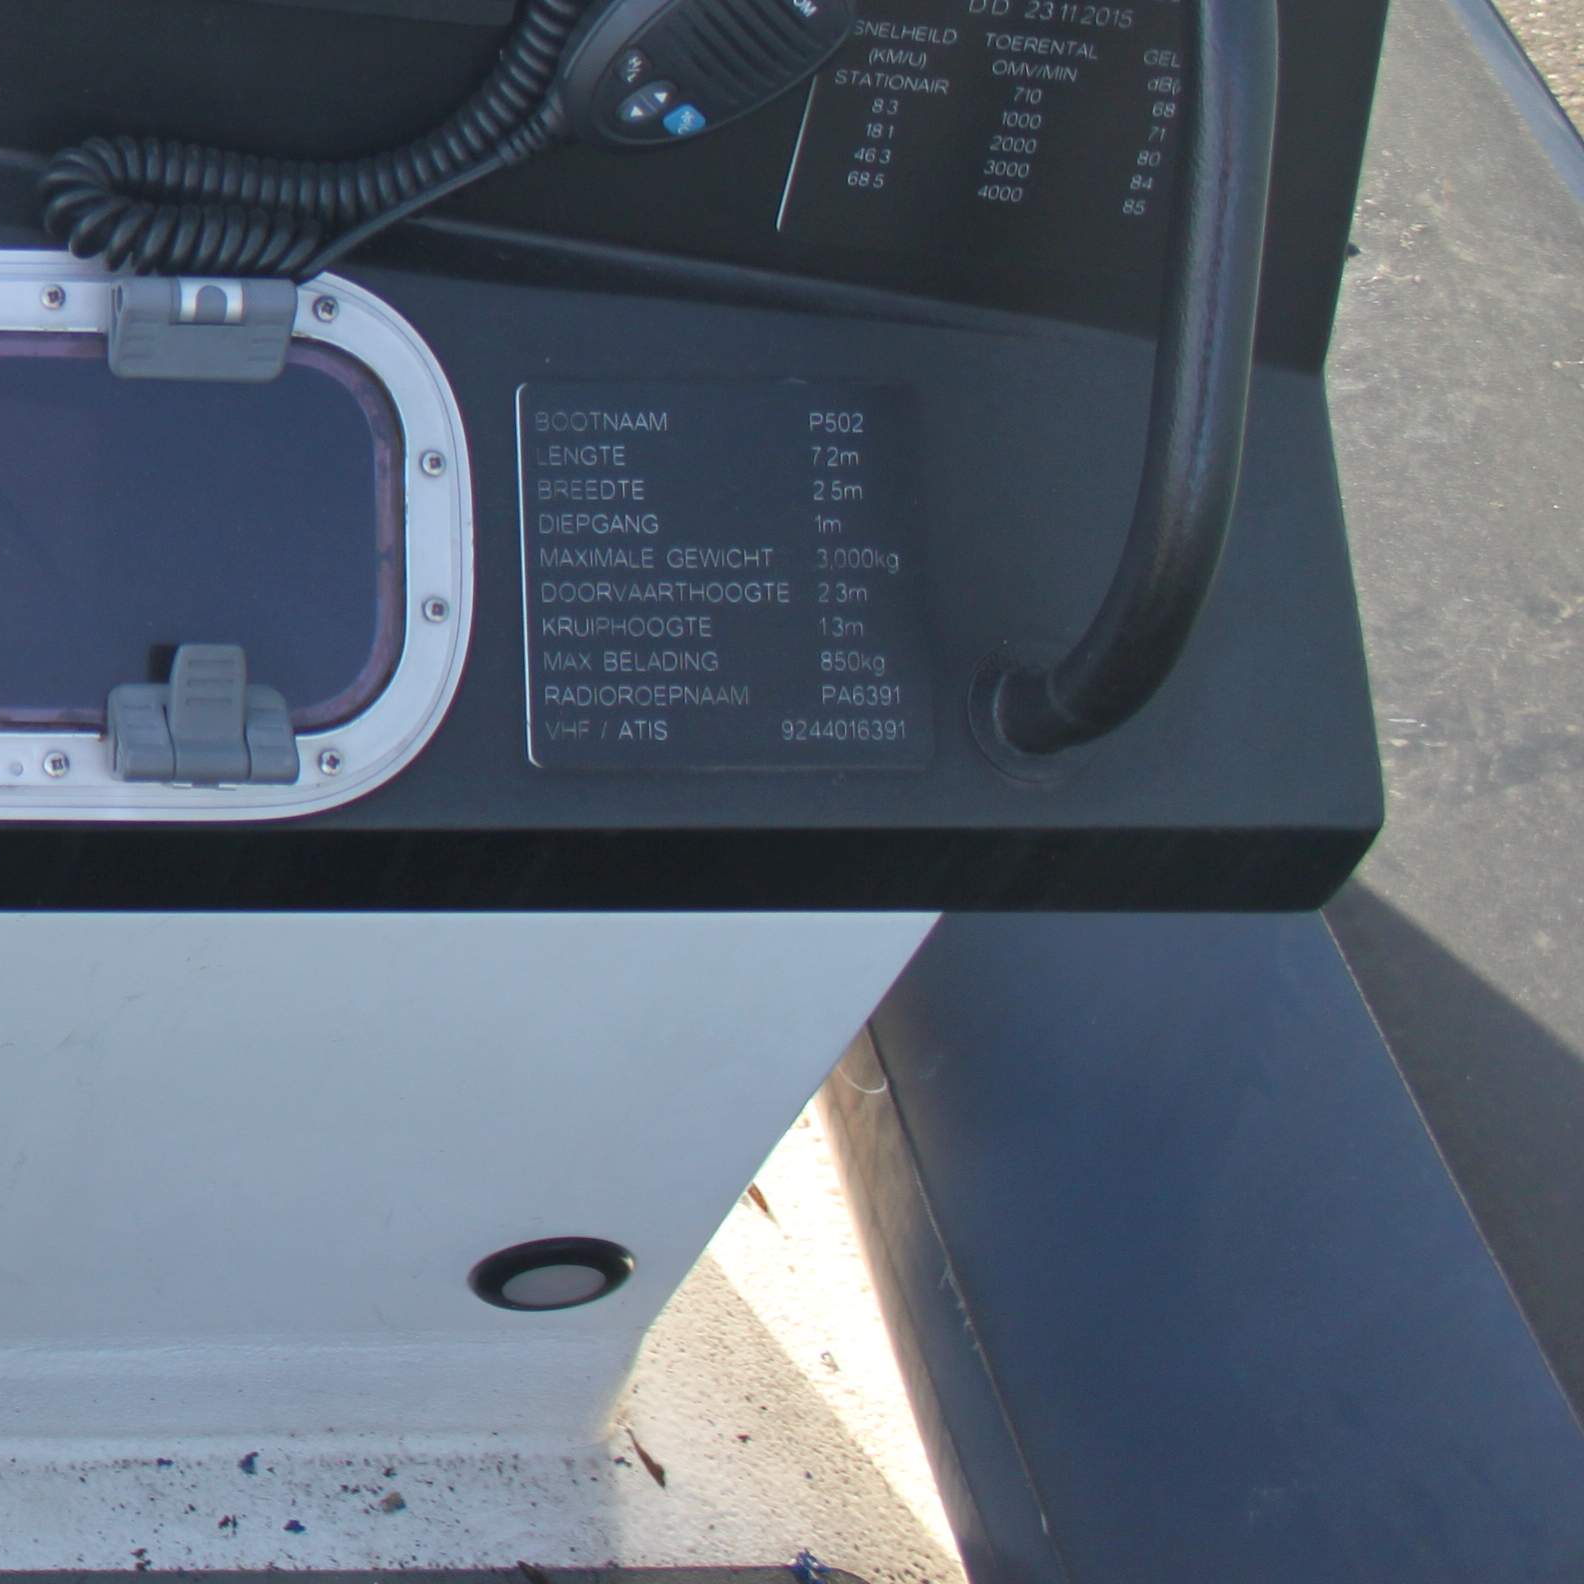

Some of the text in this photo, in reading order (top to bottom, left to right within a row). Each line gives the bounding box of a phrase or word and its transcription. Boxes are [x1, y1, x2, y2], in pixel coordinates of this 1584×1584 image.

[984, 31, 1099, 62] TOERENTAL
[868, 46, 928, 68] (KM/U)
[991, 59, 1078, 83] OMV/MIN
[834, 69, 951, 96] STATIONAIR
[1013, 86, 1042, 105] 710
[1151, 101, 1176, 118] 68
[1001, 110, 1043, 130] 1000
[988, 135, 1037, 154] 2000
[1147, 126, 1167, 143] 71
[983, 160, 1030, 179] 3000
[1136, 151, 1160, 168] 80
[1129, 174, 1153, 192] 84
[976, 184, 1024, 203] 4000
[1121, 198, 1146, 216] 85
[535, 412, 864, 433] BOOTNAAM P502
[536, 446, 626, 466] LENGTE
[538, 480, 644, 500] BREEDTE
[539, 514, 841, 534] DIEPGANG 1m
[539, 548, 654, 568] MAXIMALE
[666, 548, 774, 568] GEWICHT
[541, 582, 790, 604] DOORVAARTHOOGTE
[542, 617, 712, 637] KRUIPHOOGTE
[544, 651, 886, 675] MAX BELADING 850kg
[545, 684, 902, 706] RADIOROEPNAAM PA6391
[545, 719, 590, 740] VHF
[618, 719, 668, 740] ATIS
[781, 719, 907, 740] 9244016391
